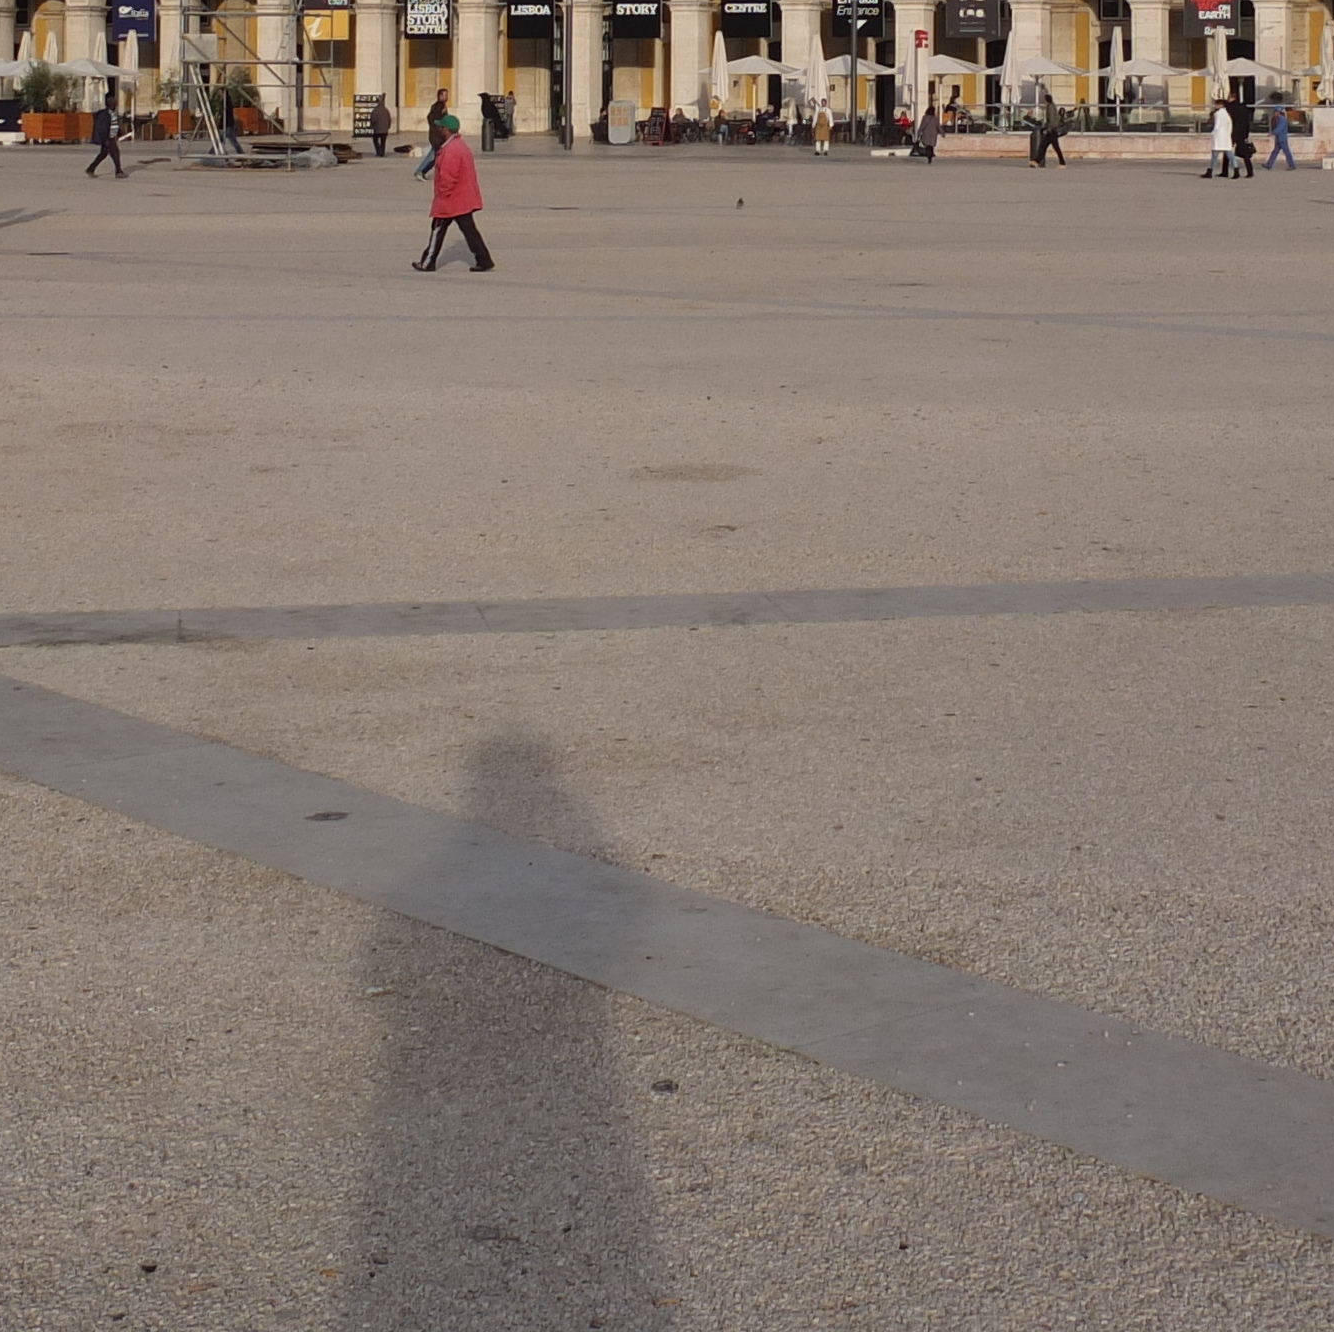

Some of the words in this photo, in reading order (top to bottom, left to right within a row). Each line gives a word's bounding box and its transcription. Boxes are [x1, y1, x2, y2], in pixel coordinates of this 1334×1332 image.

[407, 3, 448, 15] LISBOA
[510, 3, 552, 15] LISBOA
[616, 3, 658, 15] STORY
[724, 3, 767, 13] CENTRE
[836, 5, 879, 16] Enance
[407, 14, 448, 26] STORY
